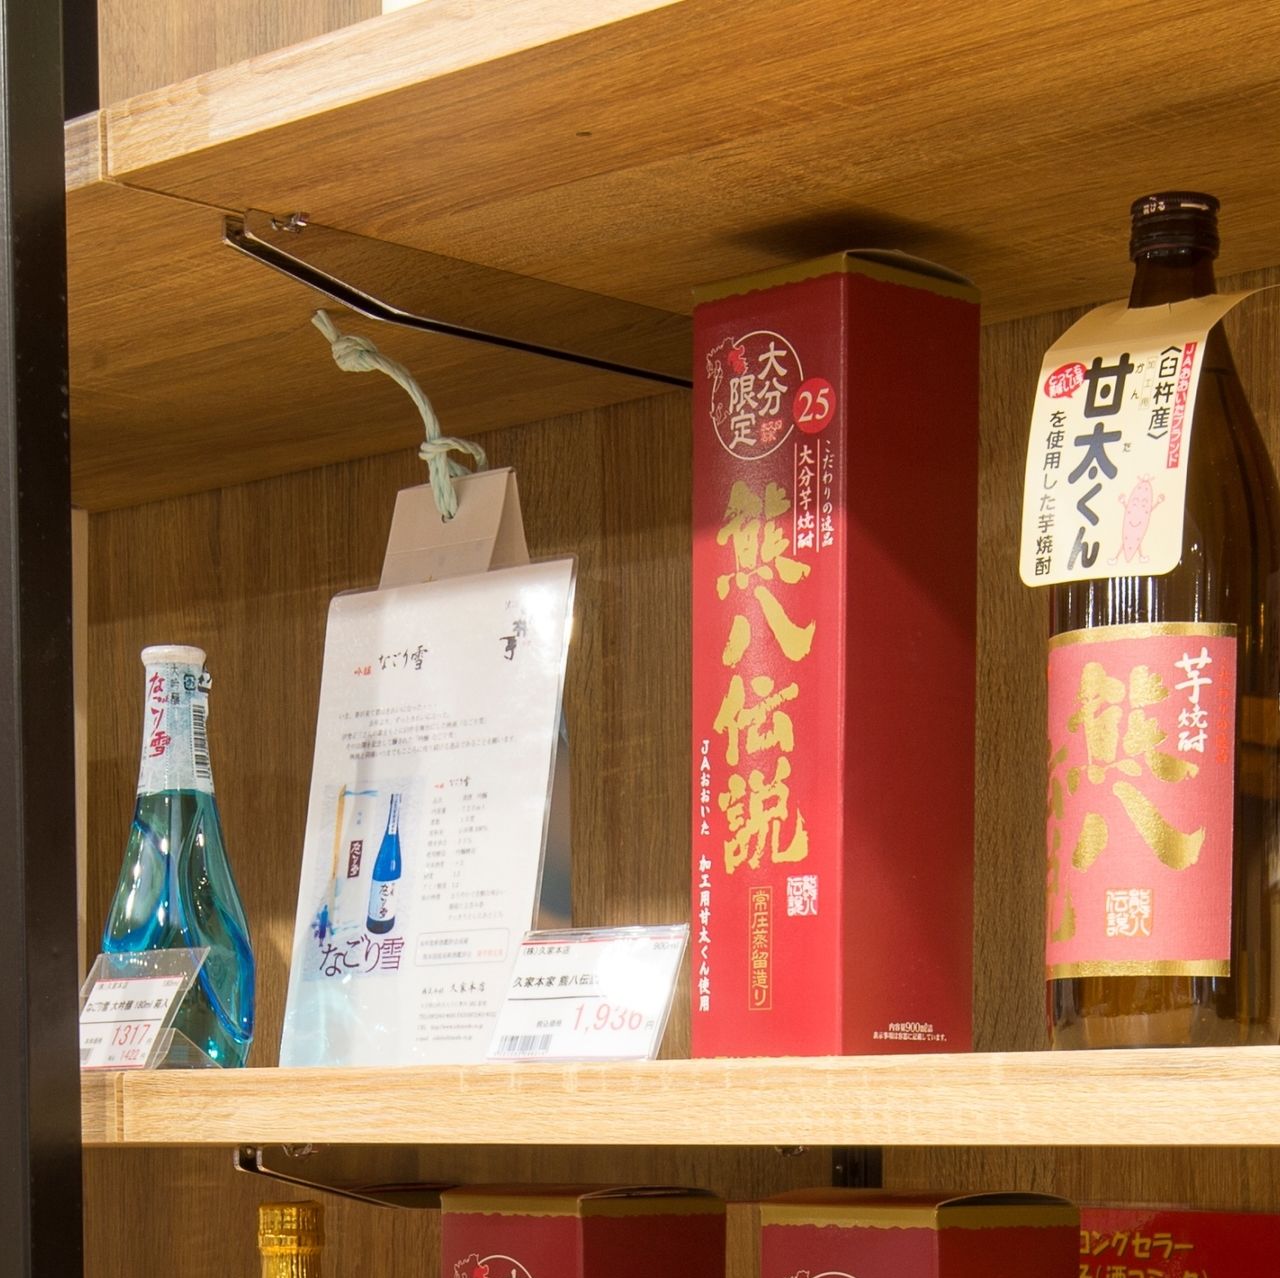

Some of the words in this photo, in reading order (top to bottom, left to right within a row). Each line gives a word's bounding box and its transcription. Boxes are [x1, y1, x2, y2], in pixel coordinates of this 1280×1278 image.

[728, 377, 757, 449] 限定
[757, 341, 788, 416] 大分
[798, 387, 831, 423] 25
[796, 445, 815, 549] 大分芋焼酎
[820, 440, 835, 548] こだわりの逸品
[1034, 410, 1067, 577] を使用した芋焼酎
[1066, 351, 1135, 572] 甘太くん
[378, 644, 429, 671] なごり雪
[714, 480, 817, 875] 熊八伝説
[1174, 646, 1214, 755] 芋焼酎
[699, 739, 711, 837] JAおおいた
[320, 933, 405, 977] なごり雪
[513, 975, 557, 988] 久家本家
[699, 855, 712, 1012] 加工用甘太くん使用
[751, 891, 769, 1007] 常圧蒸留造り
[111, 1023, 152, 1046] 1317
